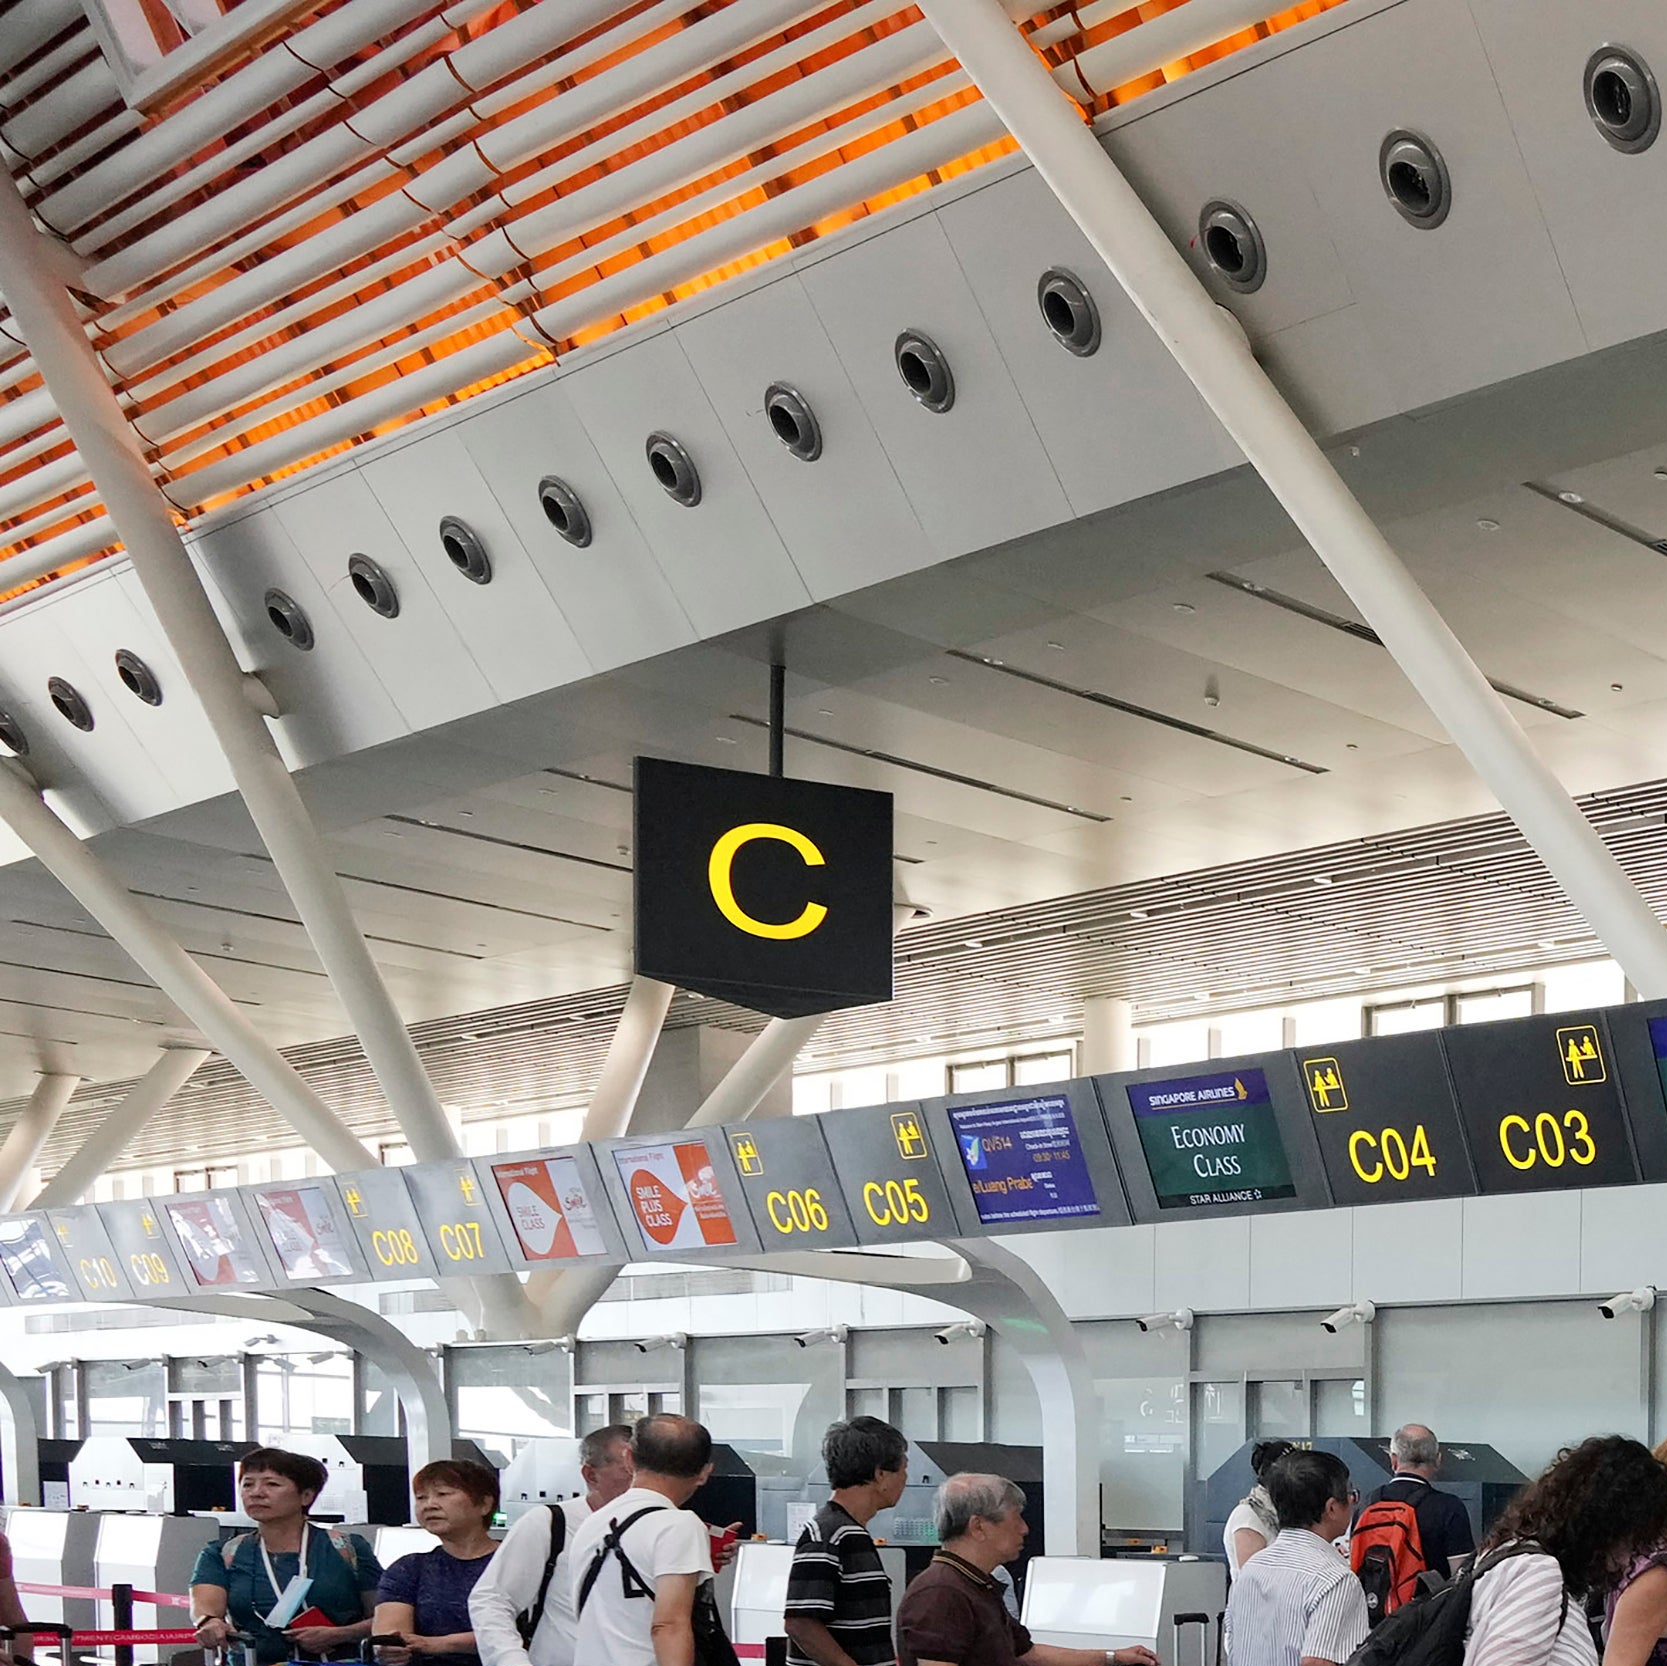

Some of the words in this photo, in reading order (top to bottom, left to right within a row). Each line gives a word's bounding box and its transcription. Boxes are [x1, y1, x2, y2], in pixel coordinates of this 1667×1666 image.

[708, 823, 828, 940] C
[1148, 1091, 1195, 1107] SINGAPORE
[1197, 1085, 1235, 1102] AIRLINES
[1170, 1123, 1246, 1150] ECONOMY
[1499, 1109, 1597, 1170] C03
[1193, 1153, 1242, 1178] CLASS
[1348, 1125, 1437, 1184] C04
[636, 1185, 662, 1199] SMILE
[640, 1199, 663, 1214] PLUS
[862, 1178, 930, 1227] C05
[1189, 1193, 1212, 1206] STAR
[1213, 1189, 1254, 1204] ALLIANCE
[516, 1205, 539, 1218] SMILE
[521, 1218, 545, 1231] CLASS
[645, 1213, 673, 1228] CLASS
[766, 1189, 829, 1235] C06
[371, 1228, 420, 1267] C08
[439, 1221, 485, 1262] C07
[80, 1257, 118, 1289] C10
[129, 1252, 170, 1286] C09
